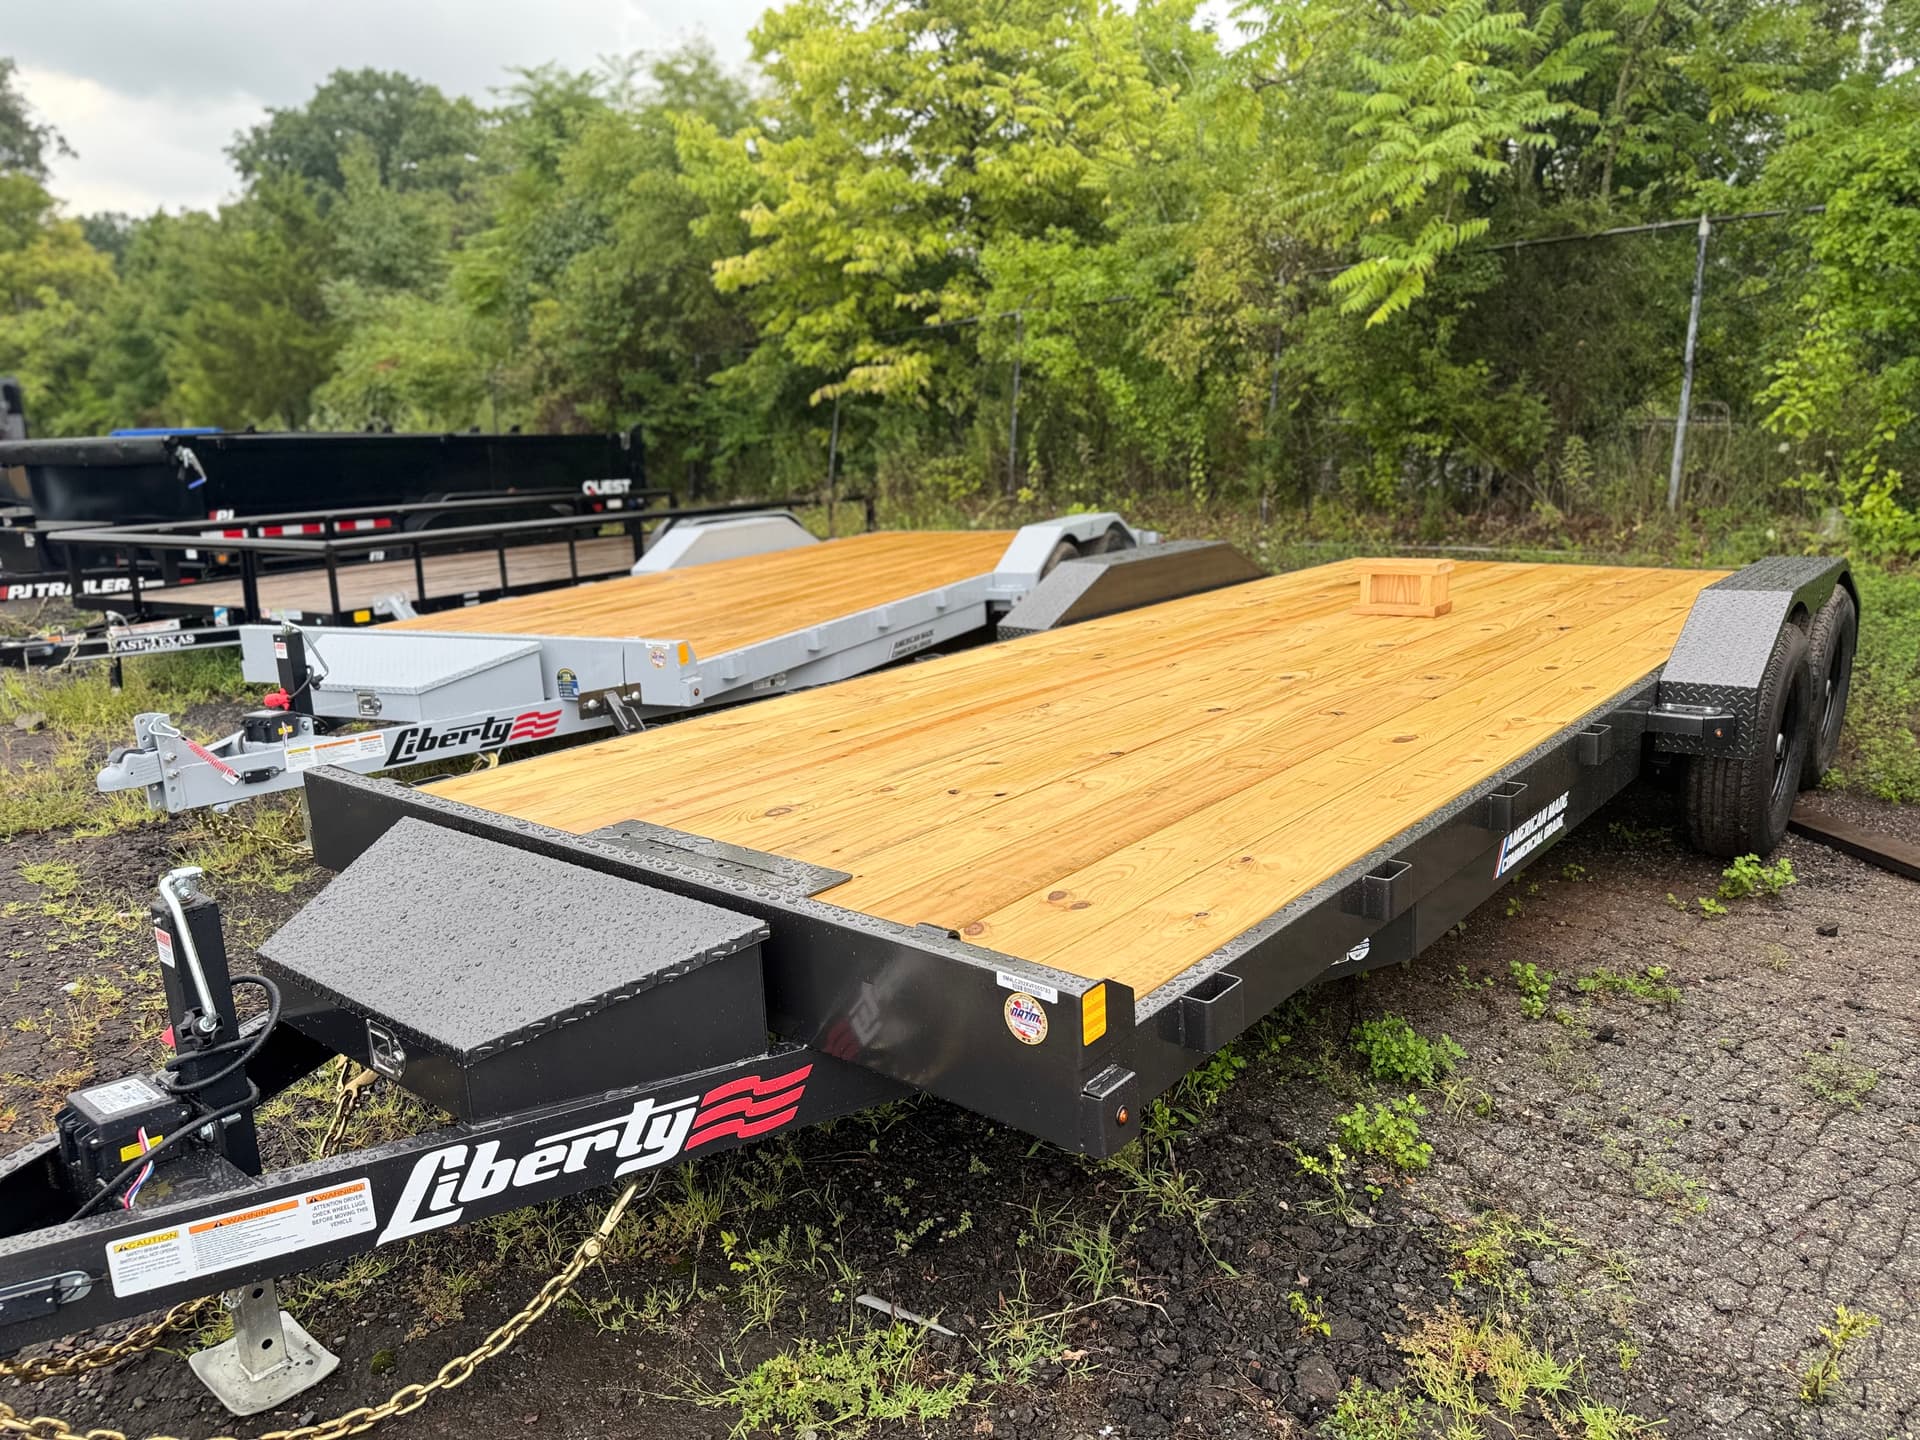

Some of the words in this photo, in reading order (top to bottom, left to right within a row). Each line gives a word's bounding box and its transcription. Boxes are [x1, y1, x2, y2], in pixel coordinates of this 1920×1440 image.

[583, 478, 632, 496] QUEST
[8, 585, 33, 600] PJ
[116, 639, 146, 652] AST
[146, 633, 196, 650] TEXAS
[384, 717, 514, 767] Liberty
[1506, 806, 1548, 853] AMERICAN
[1547, 790, 1570, 821] MADE
[1502, 829, 1544, 875] COMMERCIAL
[1543, 812, 1565, 841] GRADE
[375, 1096, 700, 1247] Liberty
[320, 1183, 365, 1200] WARNING
[227, 1207, 277, 1225] WARNING
[312, 1209, 331, 1219] CHECK
[332, 1203, 351, 1213] WHEEL
[351, 1199, 366, 1208] LUGS
[312, 1215, 333, 1226] BEFORE
[334, 1209, 356, 1220] MOVING
[356, 1205, 369, 1214] THIS
[330, 1217, 352, 1228] VEHICLE
[127, 1231, 177, 1250] CAUTION
